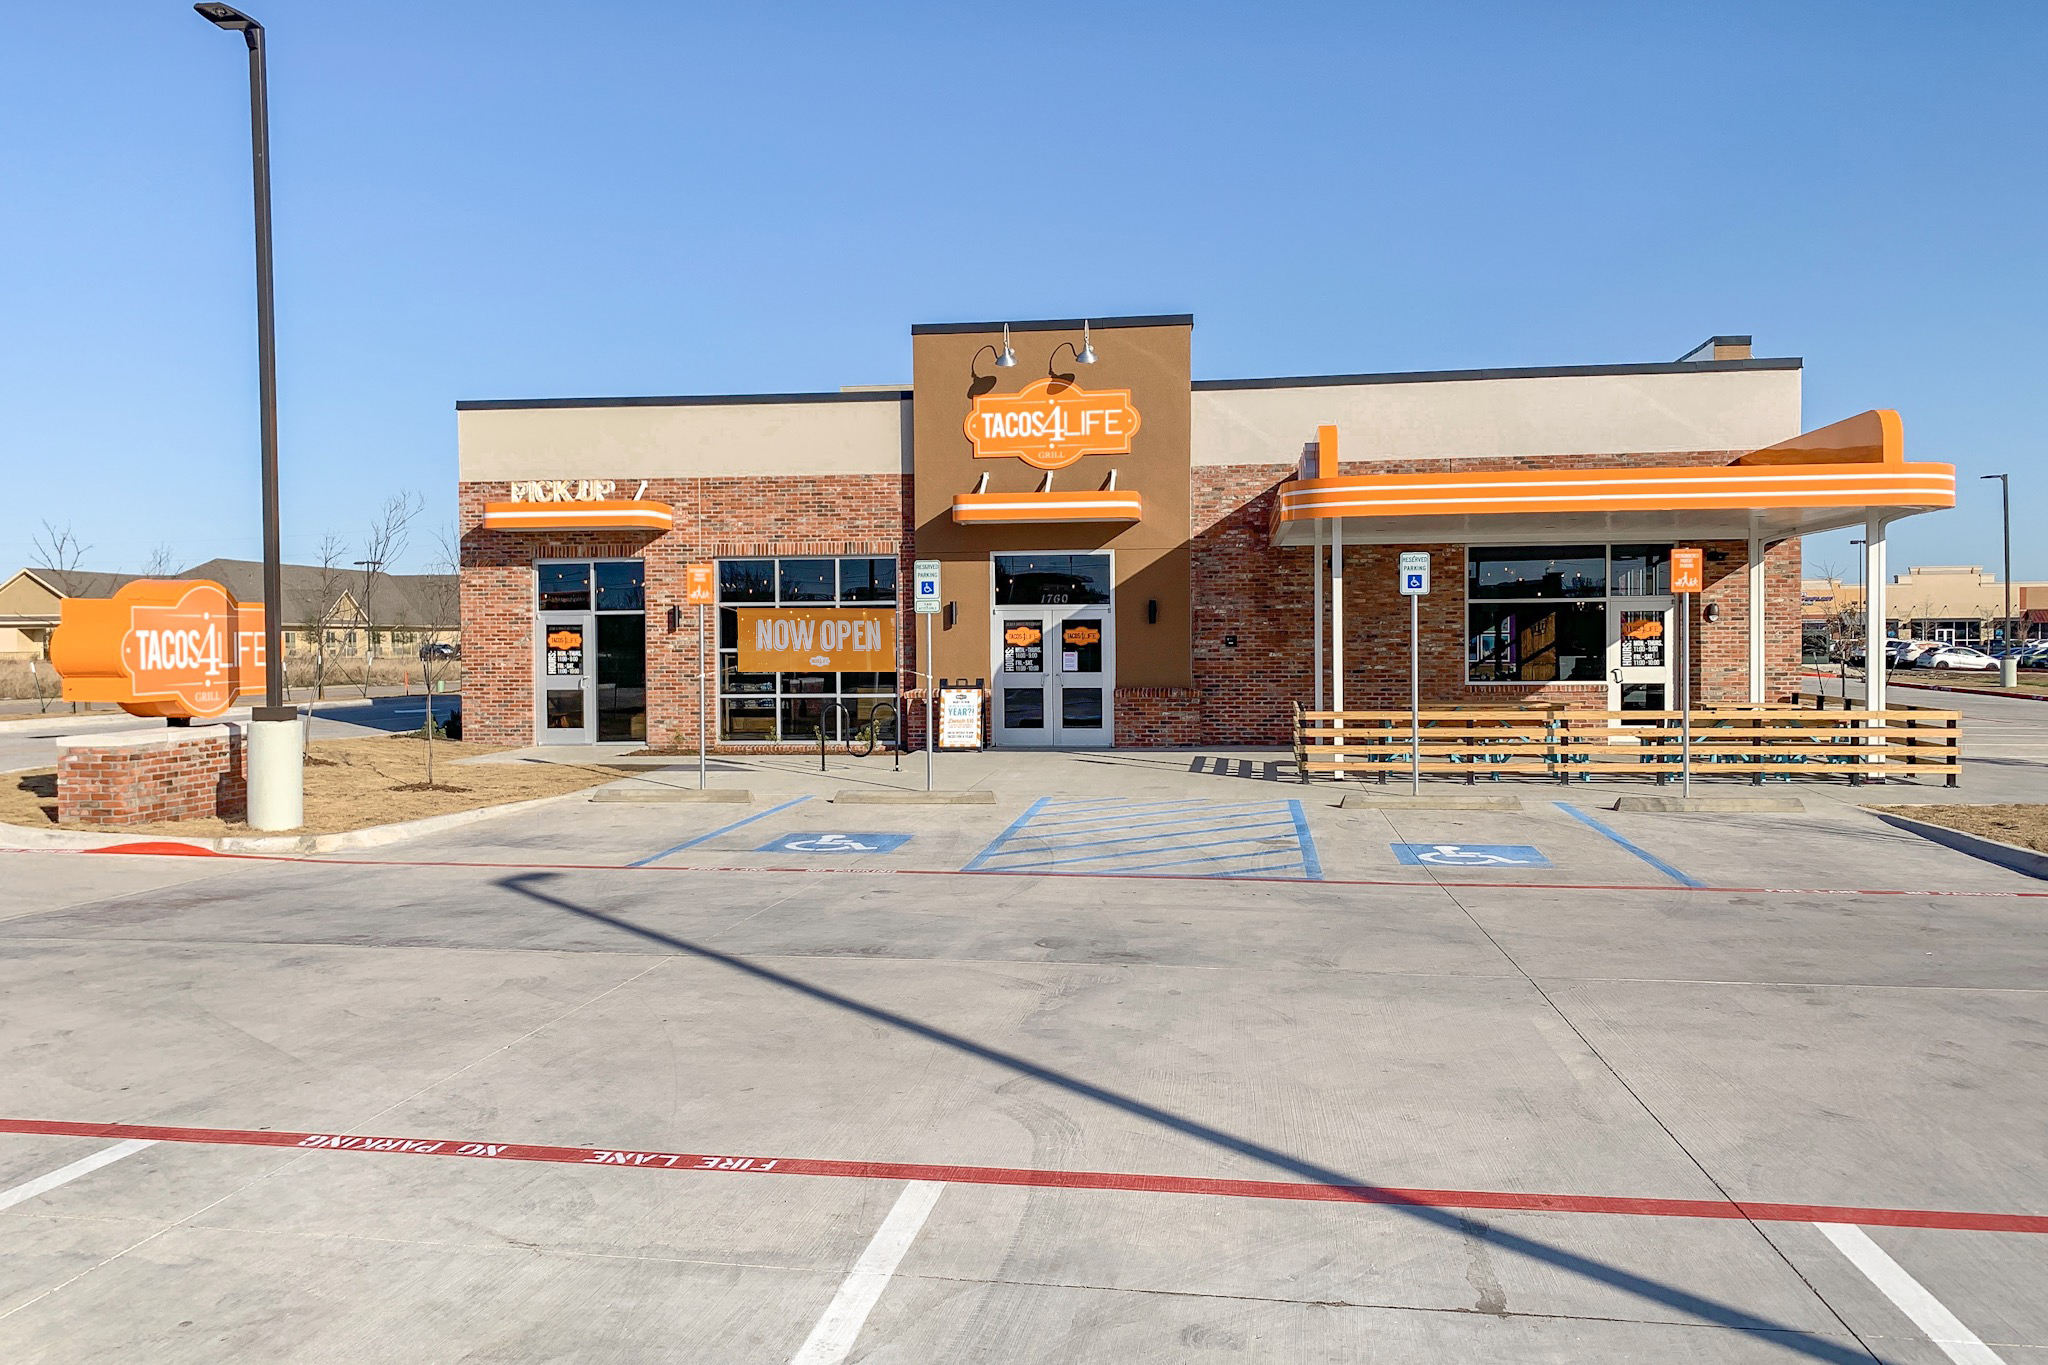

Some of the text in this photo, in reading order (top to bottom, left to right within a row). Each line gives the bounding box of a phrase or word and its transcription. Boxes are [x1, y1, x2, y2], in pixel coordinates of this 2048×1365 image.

[1038, 451, 1066, 459] GRILL
[511, 479, 616, 502] PICK UP
[1041, 594, 1069, 604] 1760
[756, 619, 882, 651] NOW OPEN
[194, 691, 221, 702] GRILL
[948, 708, 975, 717] YEAR?!
[298, 1135, 778, 1172] FIRE LANE NO PARKING
